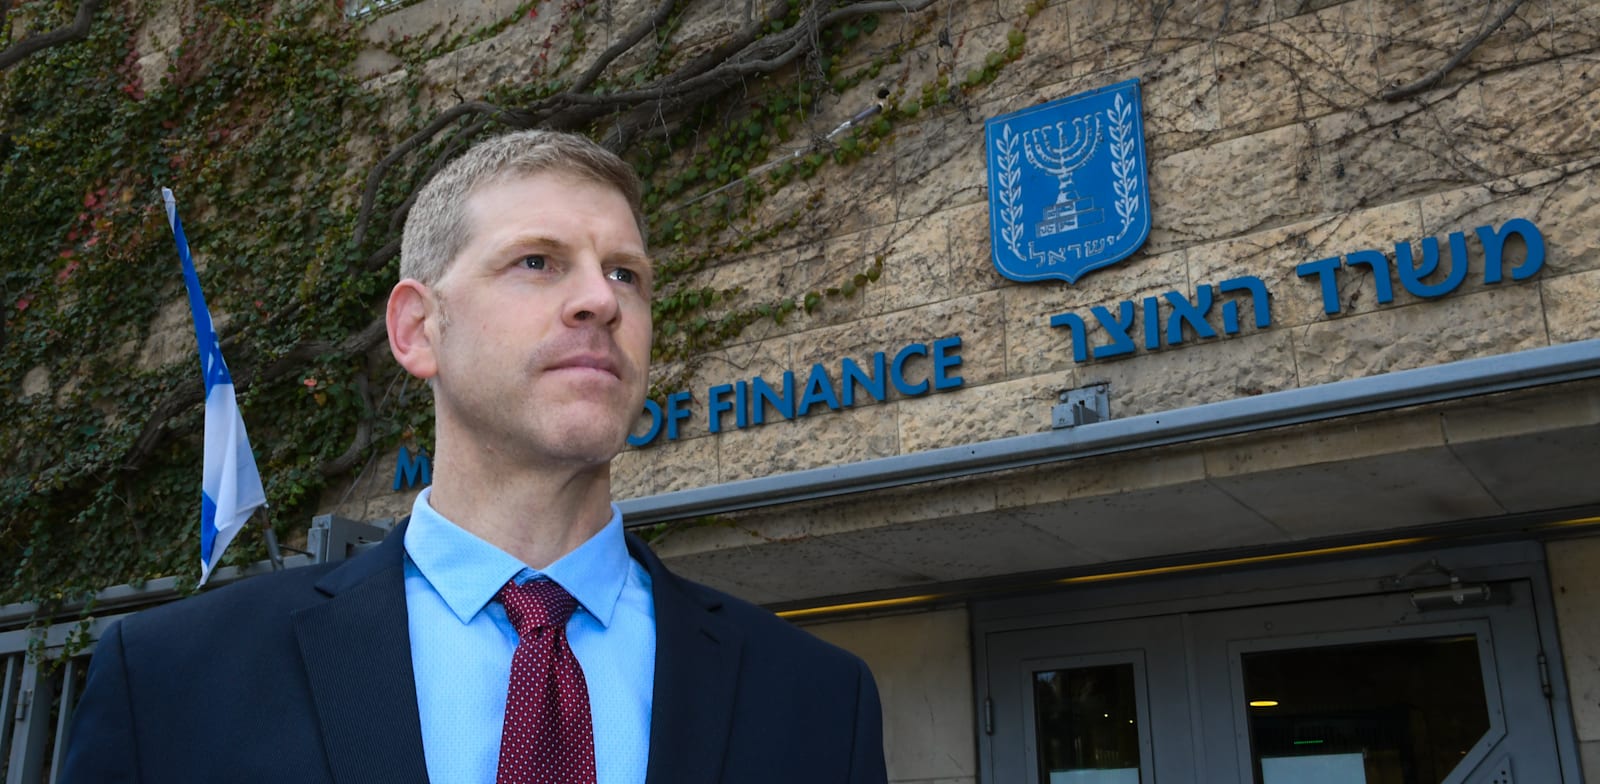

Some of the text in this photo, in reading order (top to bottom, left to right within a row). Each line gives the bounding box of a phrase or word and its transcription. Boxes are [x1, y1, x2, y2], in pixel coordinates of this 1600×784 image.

[1027, 235, 1116, 268] ישראל
[1050, 217, 1546, 363] משרד האוצר
[627, 336, 964, 447] OF FINANCE
